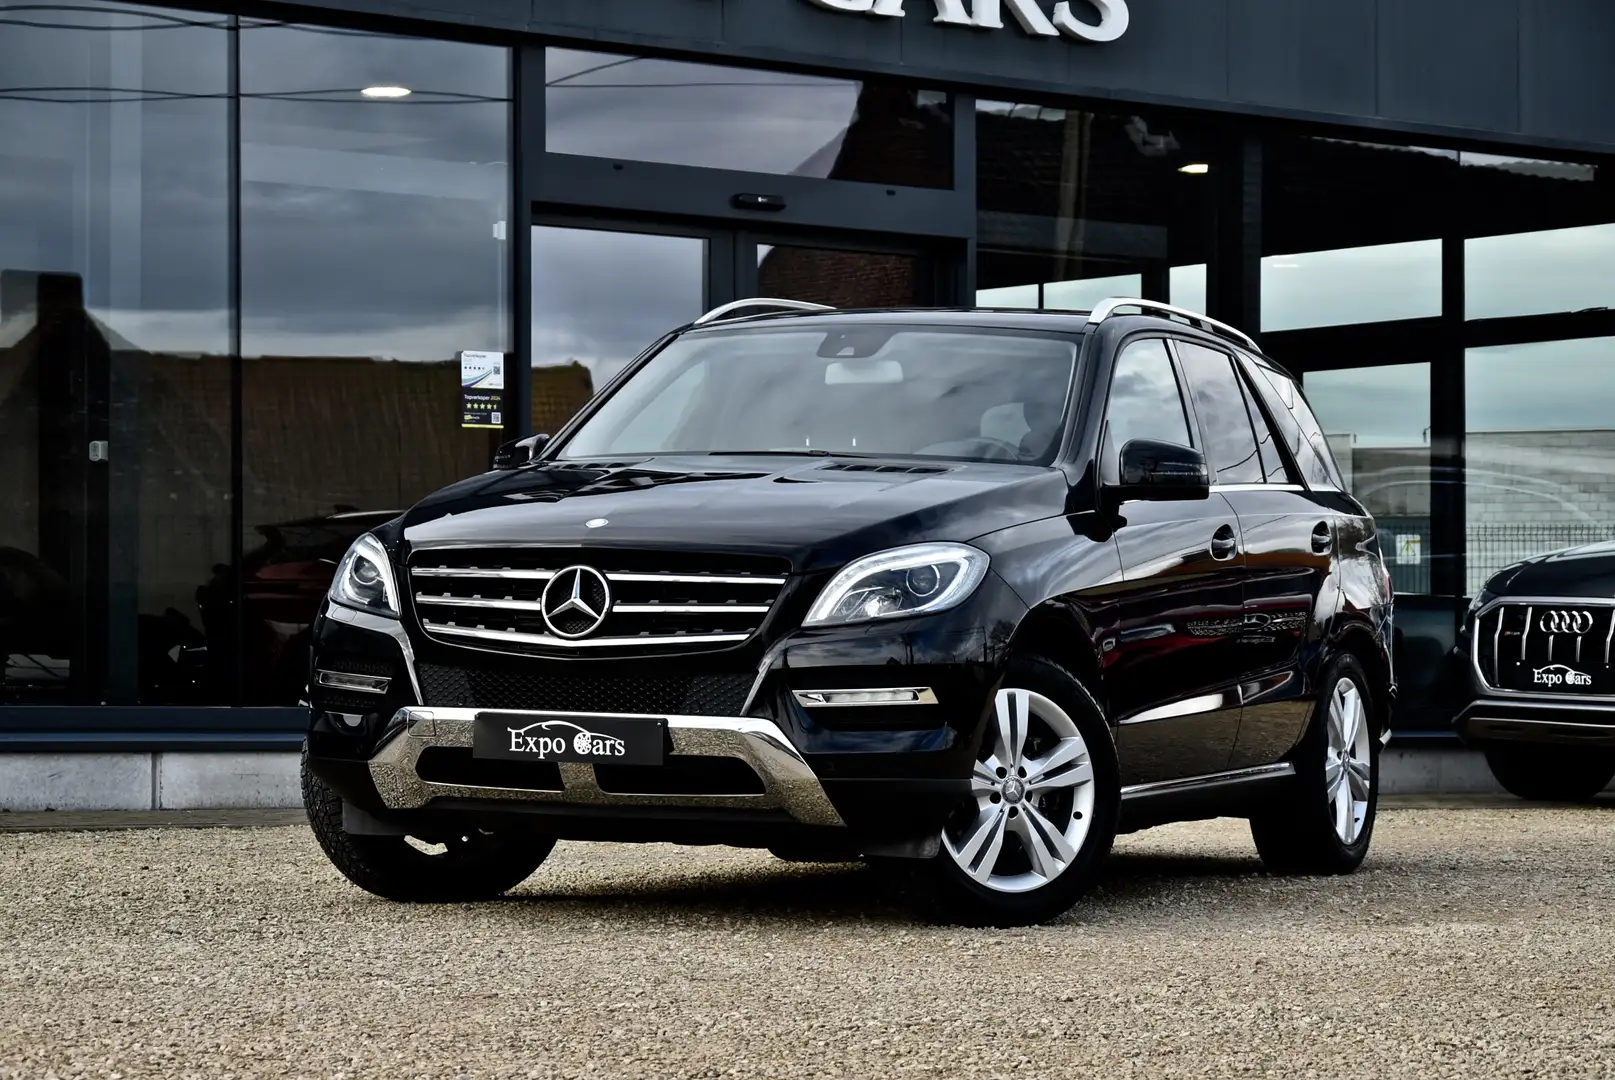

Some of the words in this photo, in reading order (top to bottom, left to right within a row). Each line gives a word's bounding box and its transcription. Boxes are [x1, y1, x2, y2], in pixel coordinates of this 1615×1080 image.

[1533, 668, 1563, 687] Expo
[1565, 671, 1592, 685] Cars
[507, 727, 566, 759] Expo
[573, 732, 626, 756] Cars
